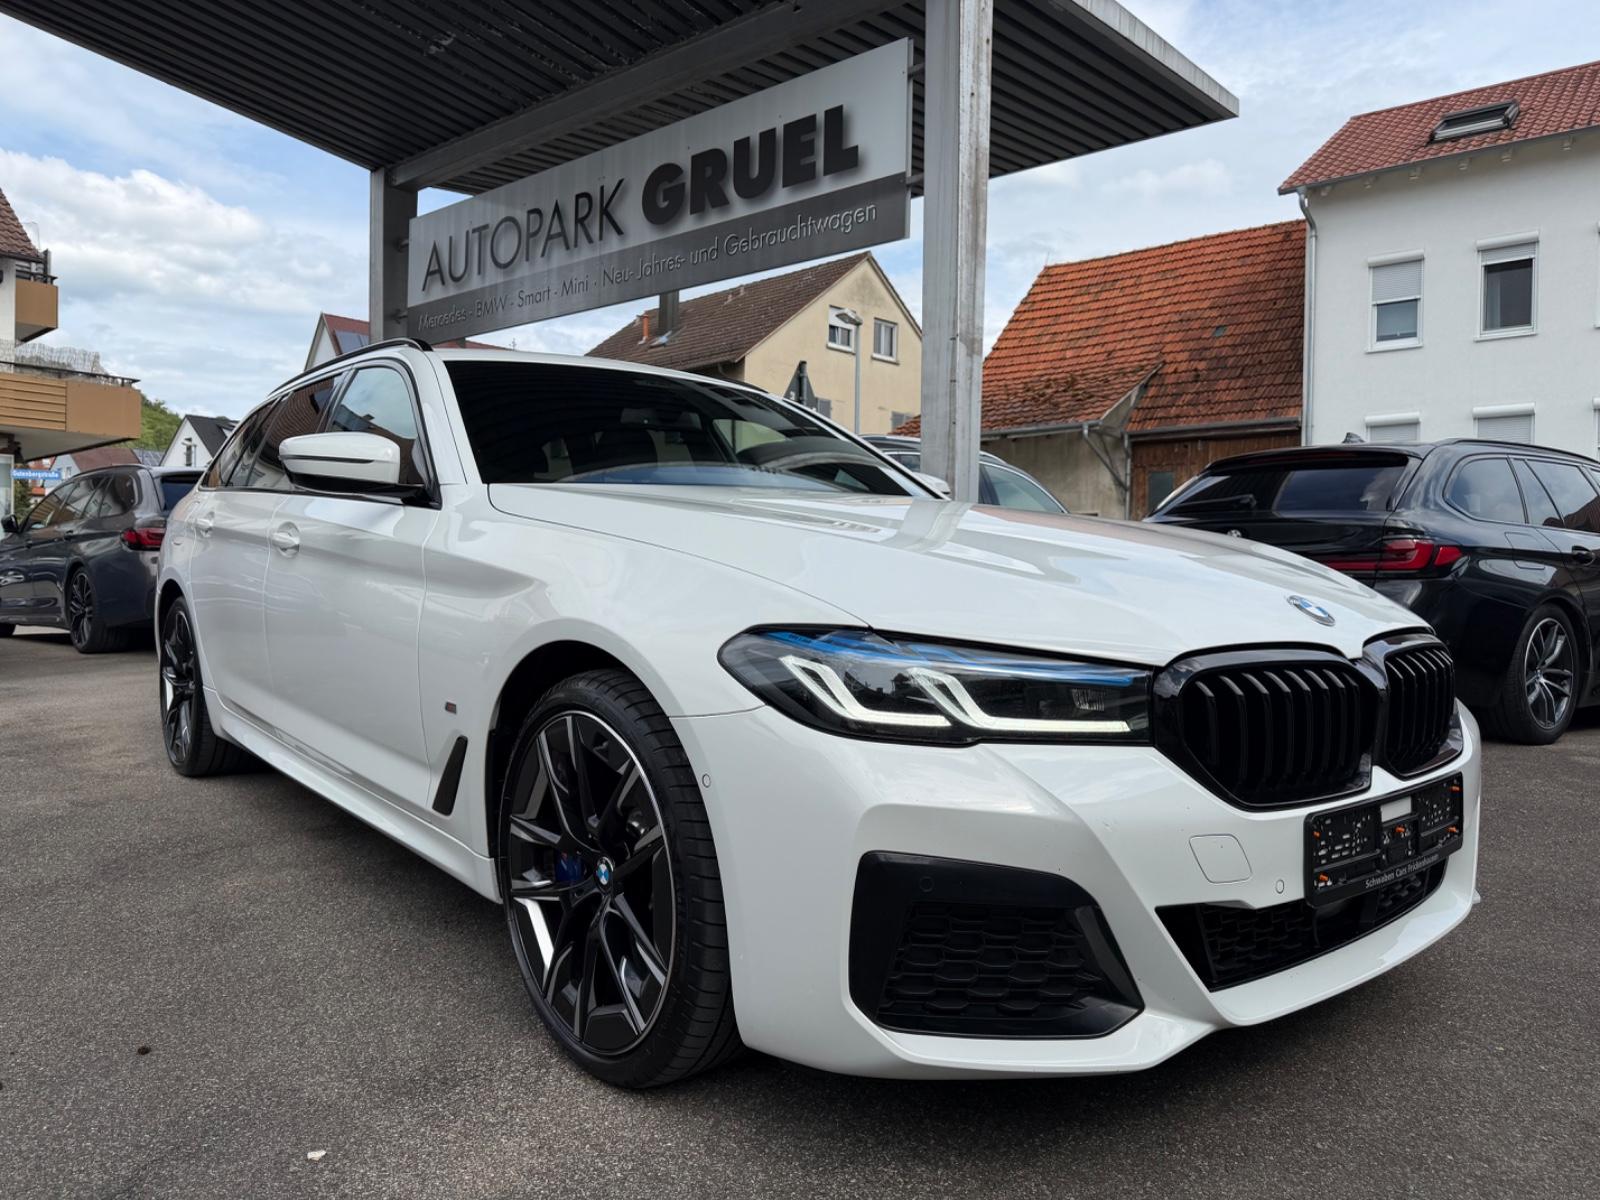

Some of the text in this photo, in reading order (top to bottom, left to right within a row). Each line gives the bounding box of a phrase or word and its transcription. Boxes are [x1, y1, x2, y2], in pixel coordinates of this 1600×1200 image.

[421, 104, 859, 292] AUTOPARK GRUEL
[418, 305, 467, 332] Mercedes
[476, 299, 508, 318] BMW
[517, 288, 550, 308] Smart
[561, 275, 588, 297] Mini
[690, 238, 718, 265] und
[723, 203, 877, 256] Gebrauchtwagen
[1365, 873, 1394, 889] Schwaben
